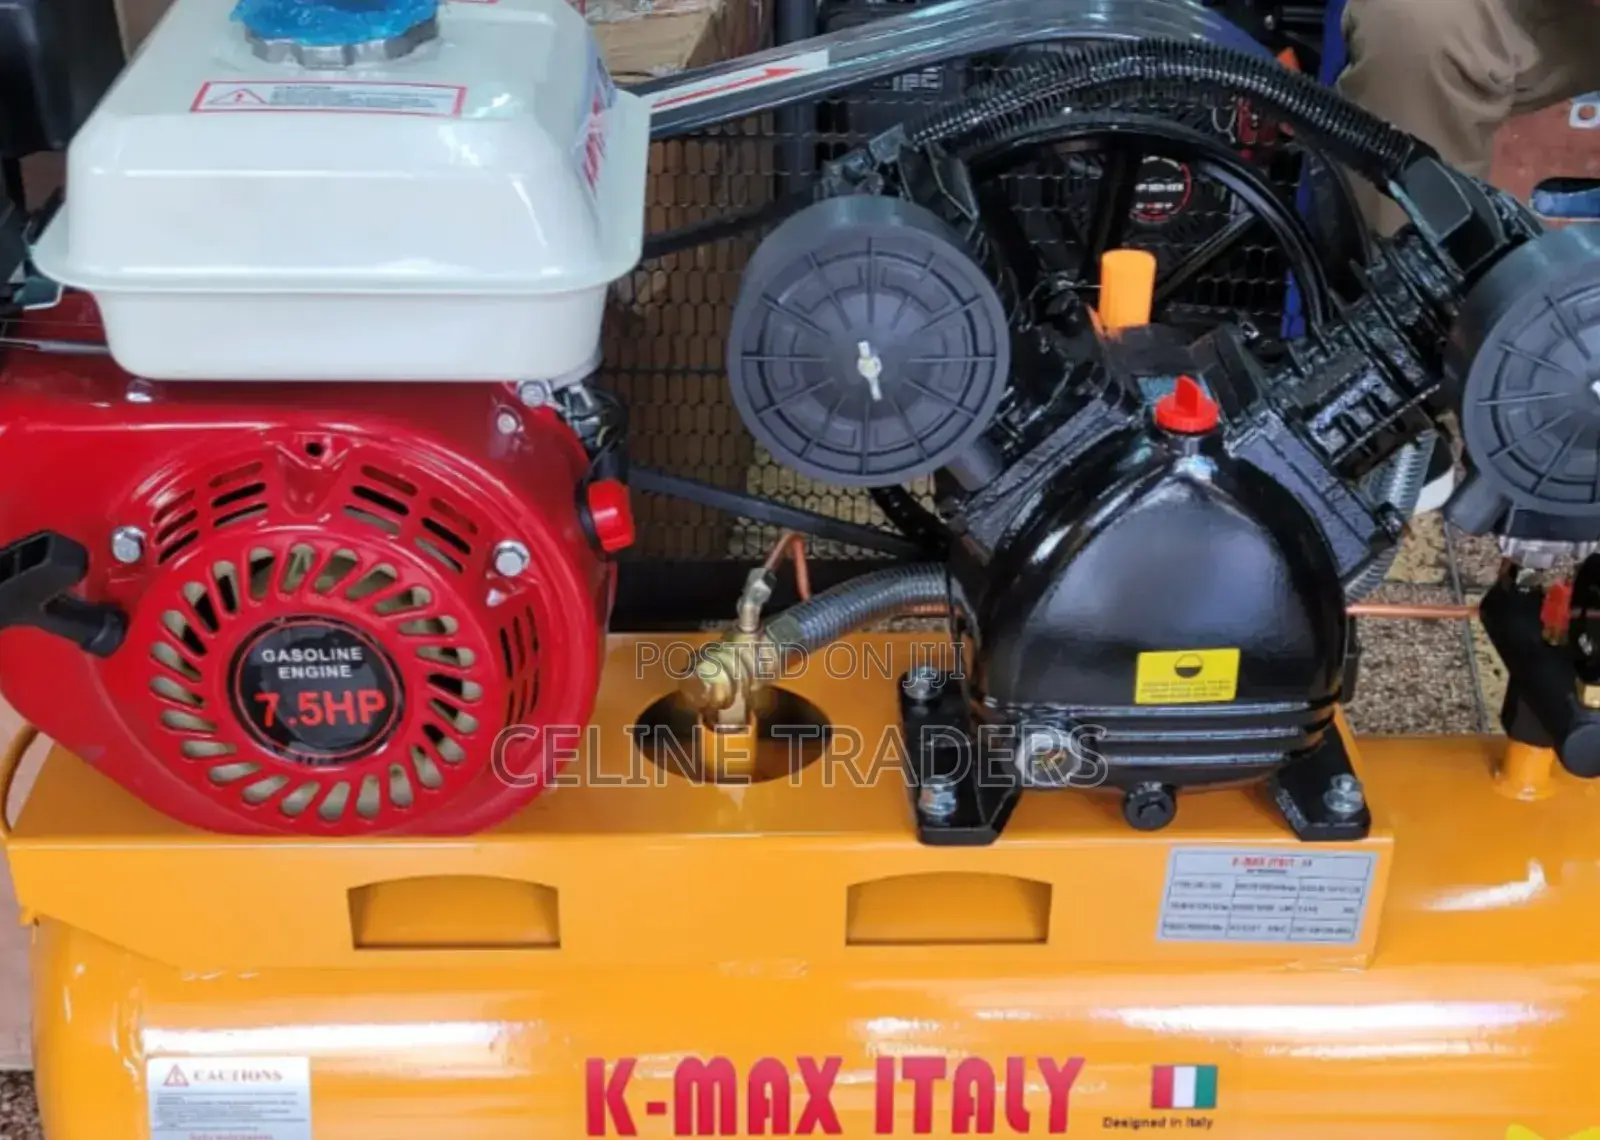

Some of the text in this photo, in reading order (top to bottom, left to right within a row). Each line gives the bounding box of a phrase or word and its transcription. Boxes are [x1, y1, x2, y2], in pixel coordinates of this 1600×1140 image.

[262, 646, 363, 662] GASOLINE
[278, 665, 353, 679] ENGINE
[254, 689, 387, 727] 7.5HP
[193, 1069, 283, 1082] CAUTIONS
[585, 1056, 1086, 1137] K-MAX ITALY
[1102, 1116, 1167, 1131] Designed
